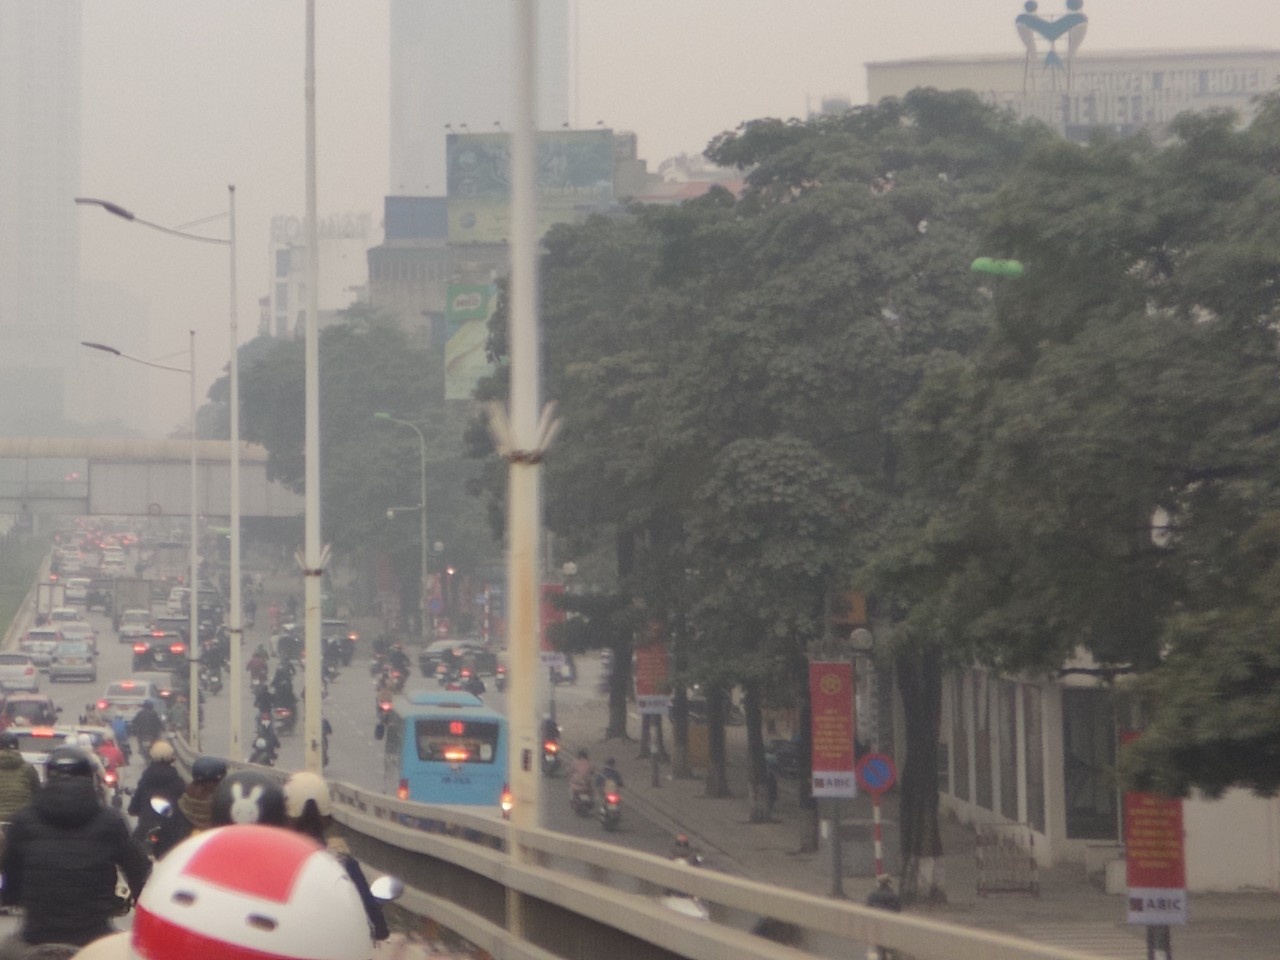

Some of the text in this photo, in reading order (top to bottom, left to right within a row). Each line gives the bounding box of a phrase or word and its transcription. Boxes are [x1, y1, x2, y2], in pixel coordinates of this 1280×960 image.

[1209, 68, 1267, 91] HOTEL
[826, 776, 851, 787] ABIC
[1146, 898, 1181, 911] ABIC
